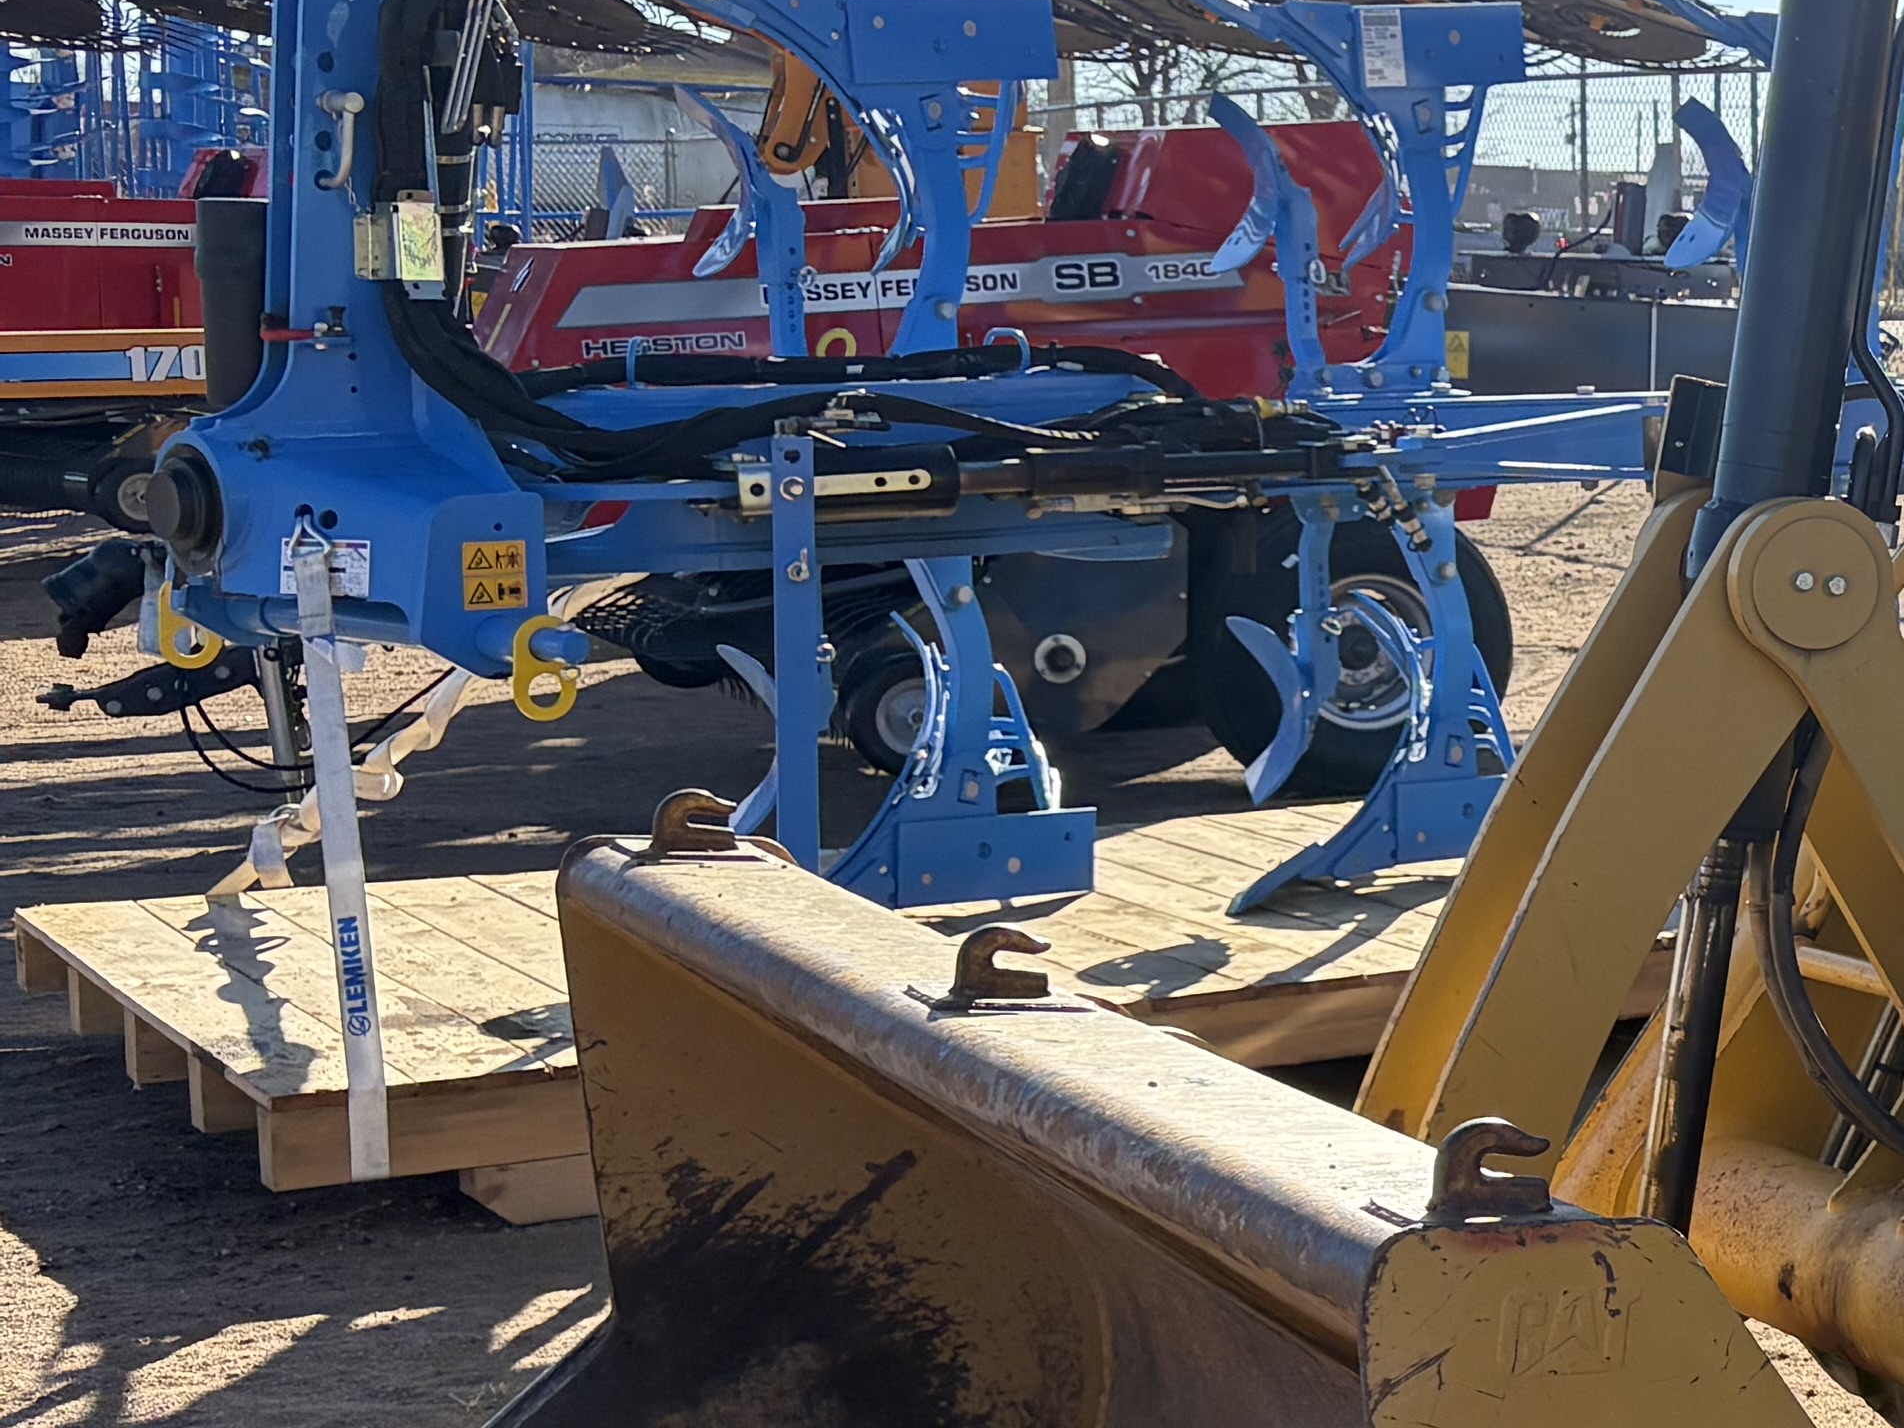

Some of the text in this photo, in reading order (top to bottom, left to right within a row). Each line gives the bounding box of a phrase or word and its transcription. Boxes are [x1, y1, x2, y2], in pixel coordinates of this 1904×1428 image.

[25, 227, 189, 241] MASSEY FERGUSON
[1055, 261, 1120, 290] SB
[337, 915, 368, 1015] LEMKEN
[1498, 1289, 1643, 1376] CAT
